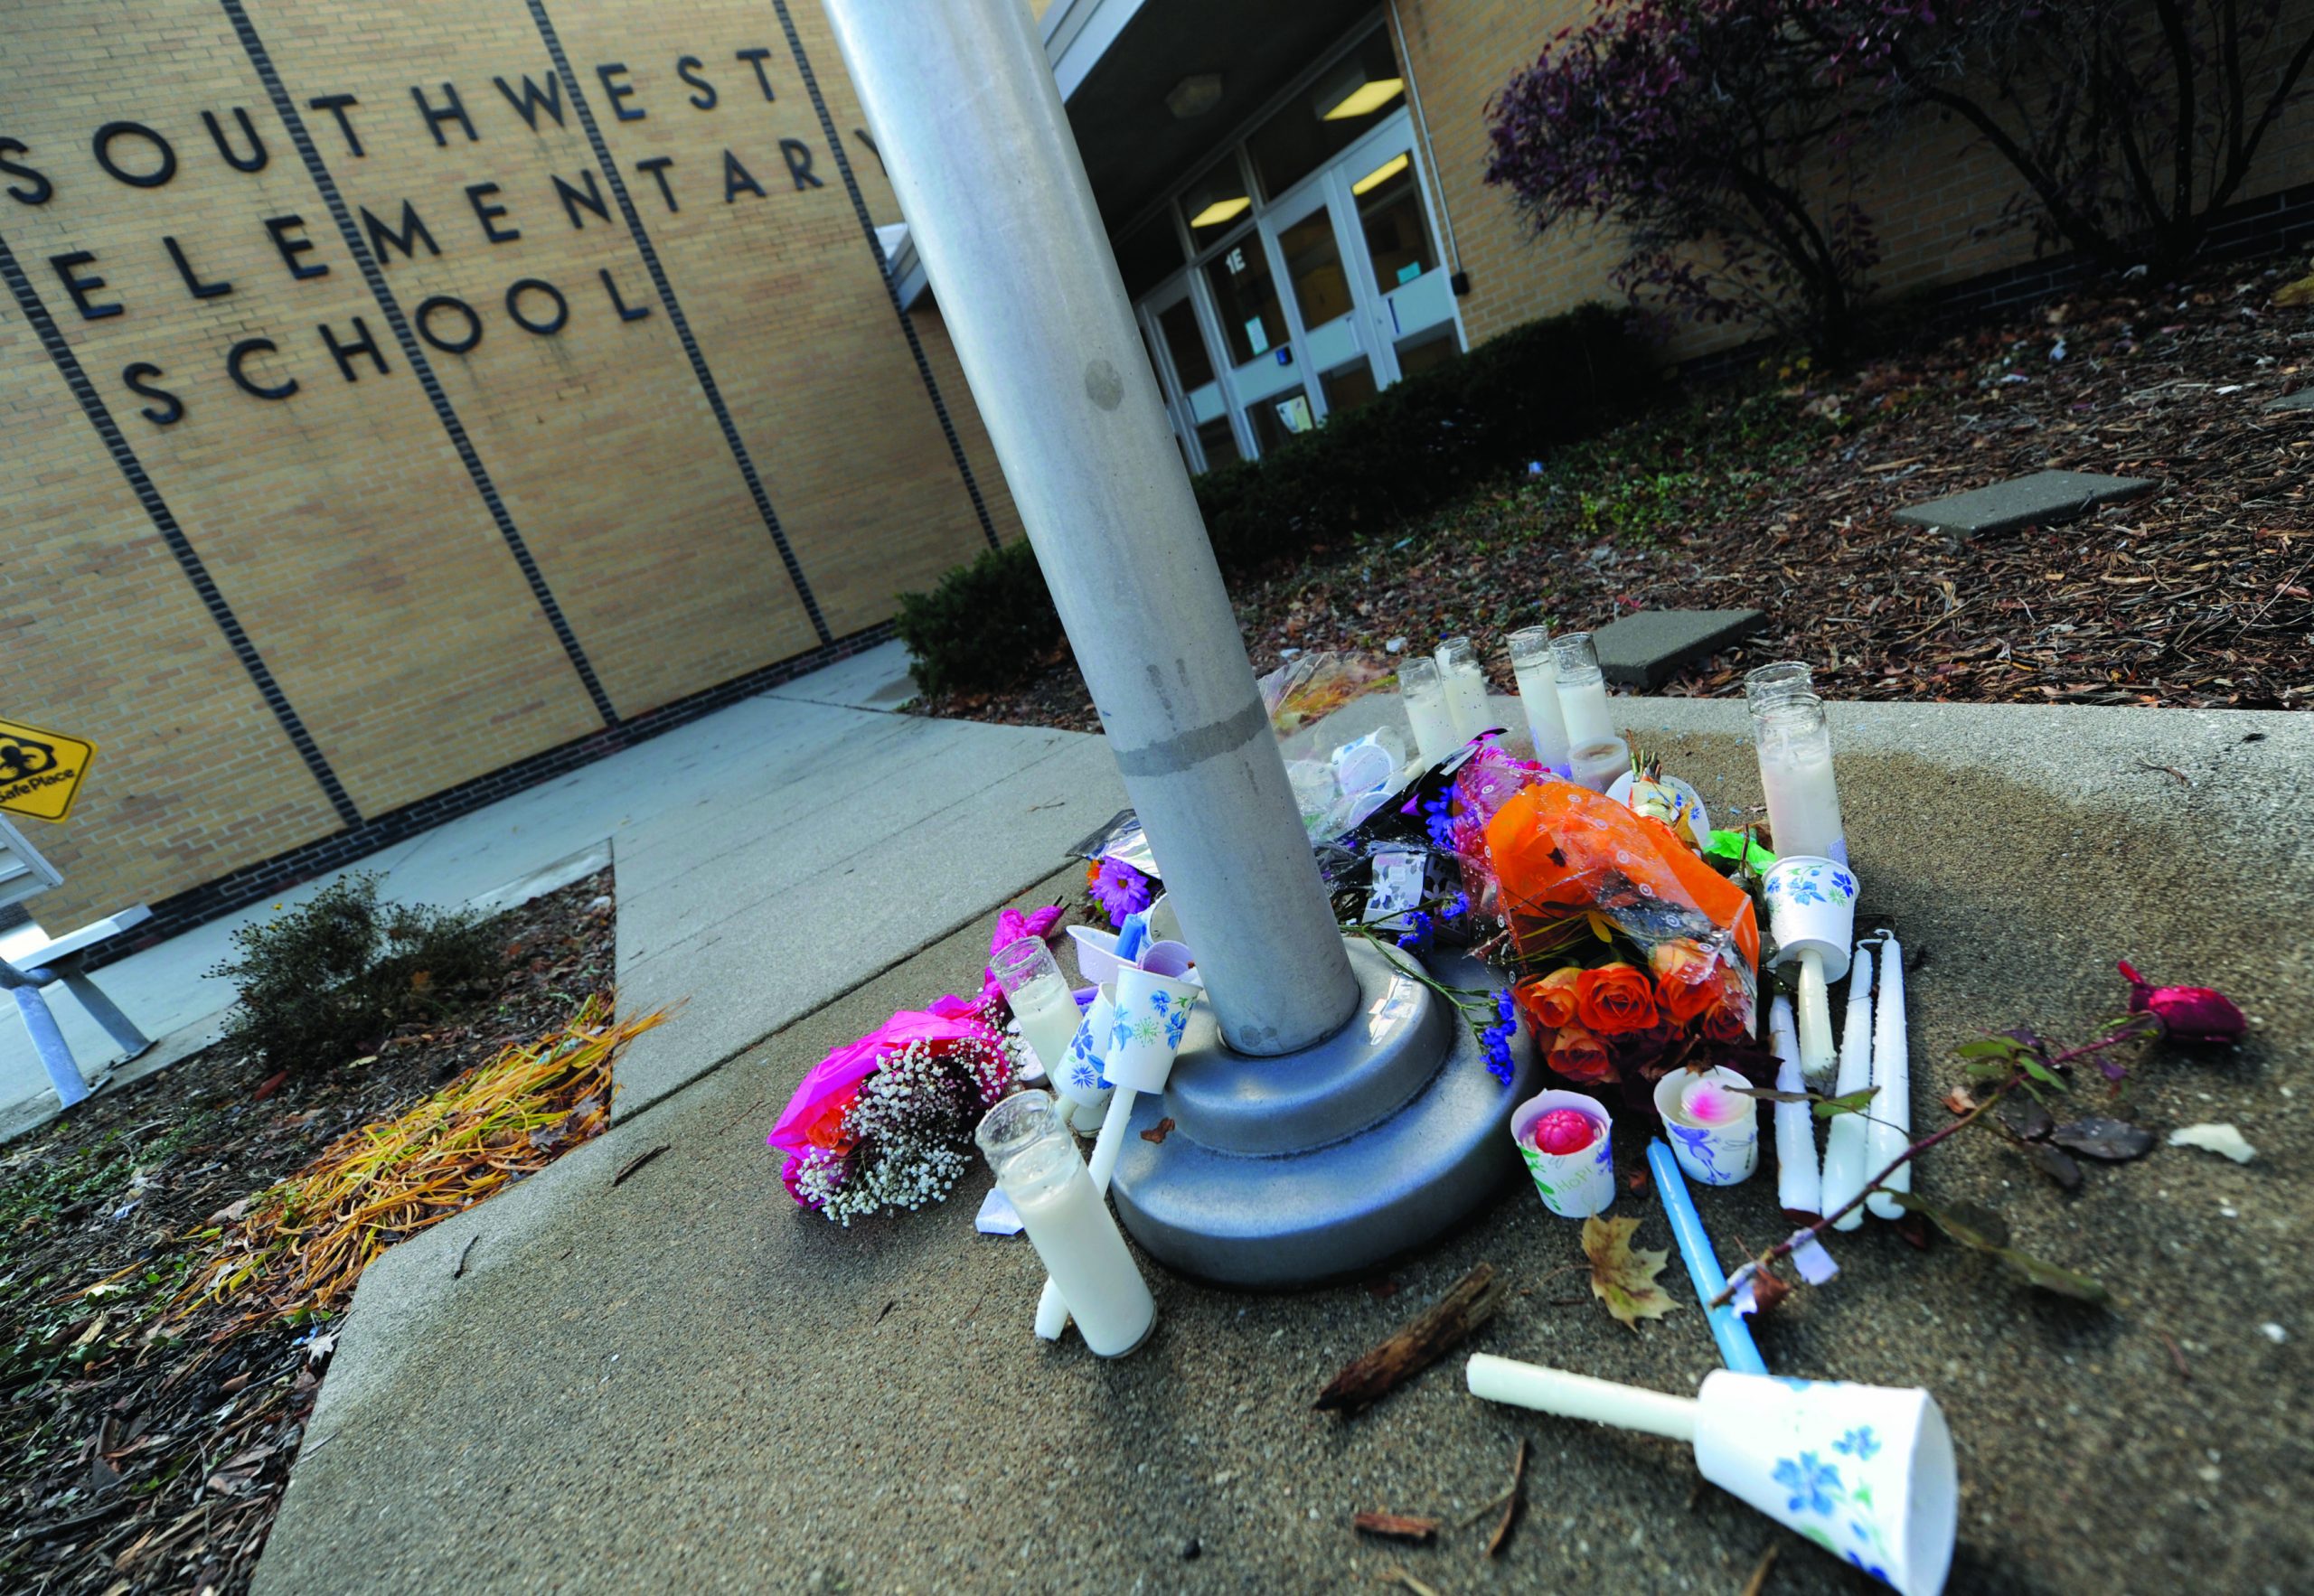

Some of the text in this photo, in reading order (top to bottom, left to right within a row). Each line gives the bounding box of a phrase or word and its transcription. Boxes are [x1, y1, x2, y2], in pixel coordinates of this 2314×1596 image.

[0, 48, 775, 206] SOUTHWEST
[1226, 247, 1246, 275] 1E
[122, 268, 650, 426] SCHOOL
[29, 769, 74, 790] Place
